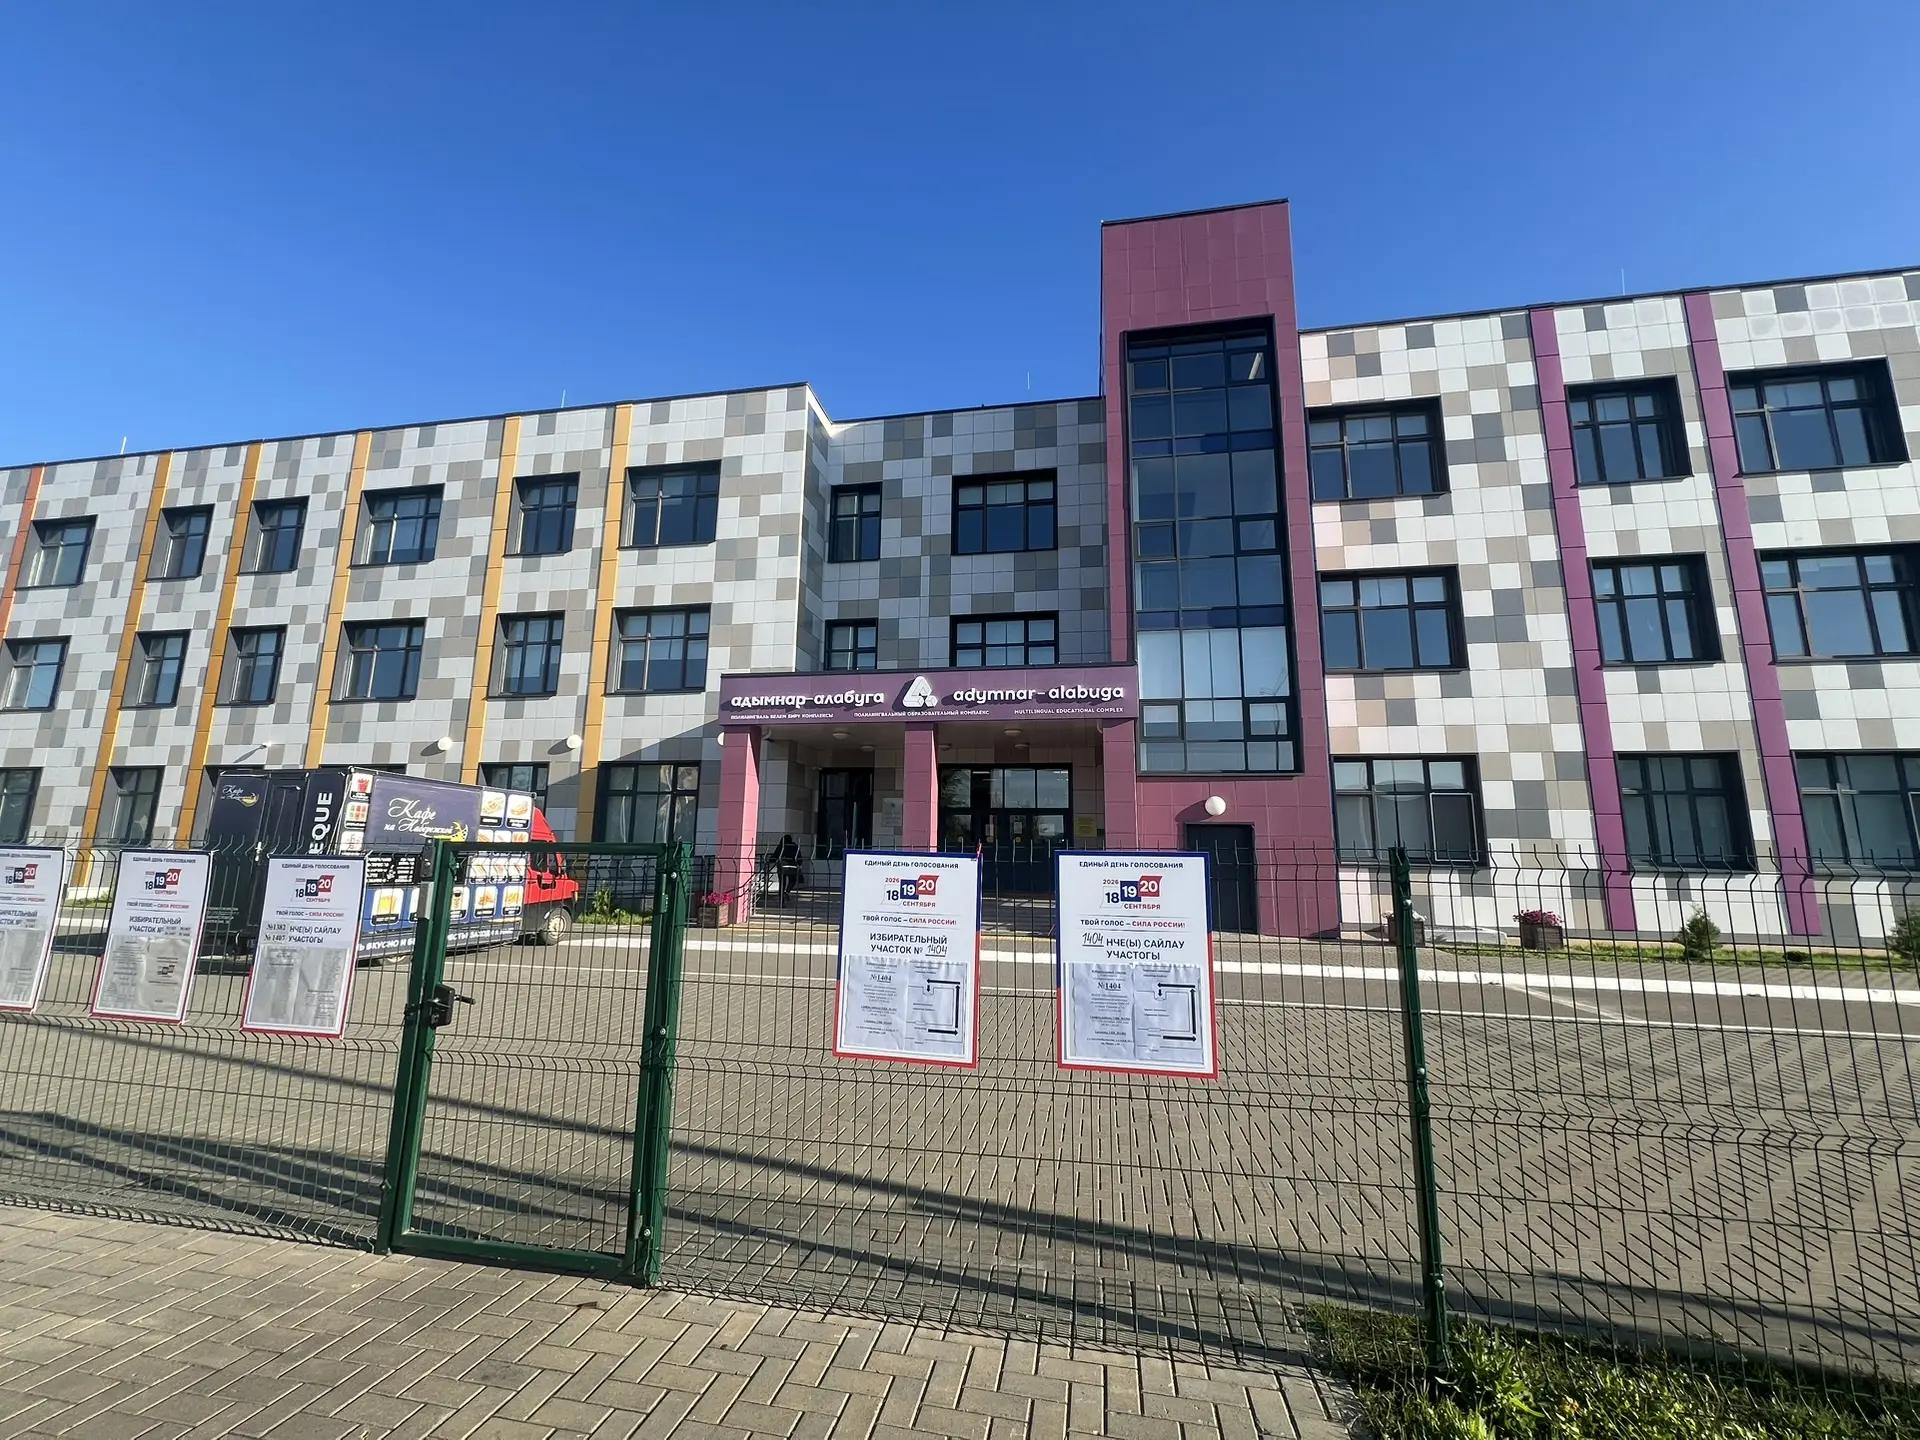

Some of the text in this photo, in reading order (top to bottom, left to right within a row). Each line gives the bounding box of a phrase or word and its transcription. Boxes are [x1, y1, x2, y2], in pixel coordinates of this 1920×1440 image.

[907, 709, 959, 717] ОБРАЗОВАТЕЛЬНЫЙ
[387, 797, 438, 826] Кафе
[864, 859, 892, 867] ЕДИНЫЙ
[911, 861, 959, 869] ГОЛОСОВАНИЯ
[1079, 860, 1109, 868] ЕДИНЫЙ
[5, 867, 36, 884] 18 19 20
[144, 872, 178, 890] 18 19 20
[295, 879, 331, 898] 18 19 20
[886, 879, 935, 901] 18 19 20
[1104, 880, 1159, 903] 18 19 20
[129, 915, 182, 925] ИЗБИРАТЕЛЬНЫЙ
[863, 914, 880, 922] ТВОЙ
[928, 918, 957, 926] РОССИИ!
[1080, 918, 1100, 926] ТВОЙ
[1100, 919, 1125, 927] ГОЛОС
[128, 925, 156, 933] УЧАСТОК
[289, 925, 313, 934] НЧЕ(Ы)
[314, 925, 342, 934] САЙЛАУ
[288, 935, 324, 944] УЧАСТОГЫ
[869, 932, 948, 945] ИЗБИРАТЕЛЬНЫЙ
[1081, 932, 1185, 949] 1404 НЧЕ(Ы) САЙЛАУ
[366, 939, 399, 950] ВКУСНО
[870, 943, 948, 955] УЧАСТОК № 1404
[1106, 950, 1160, 960] УЧАСТОГЫ
